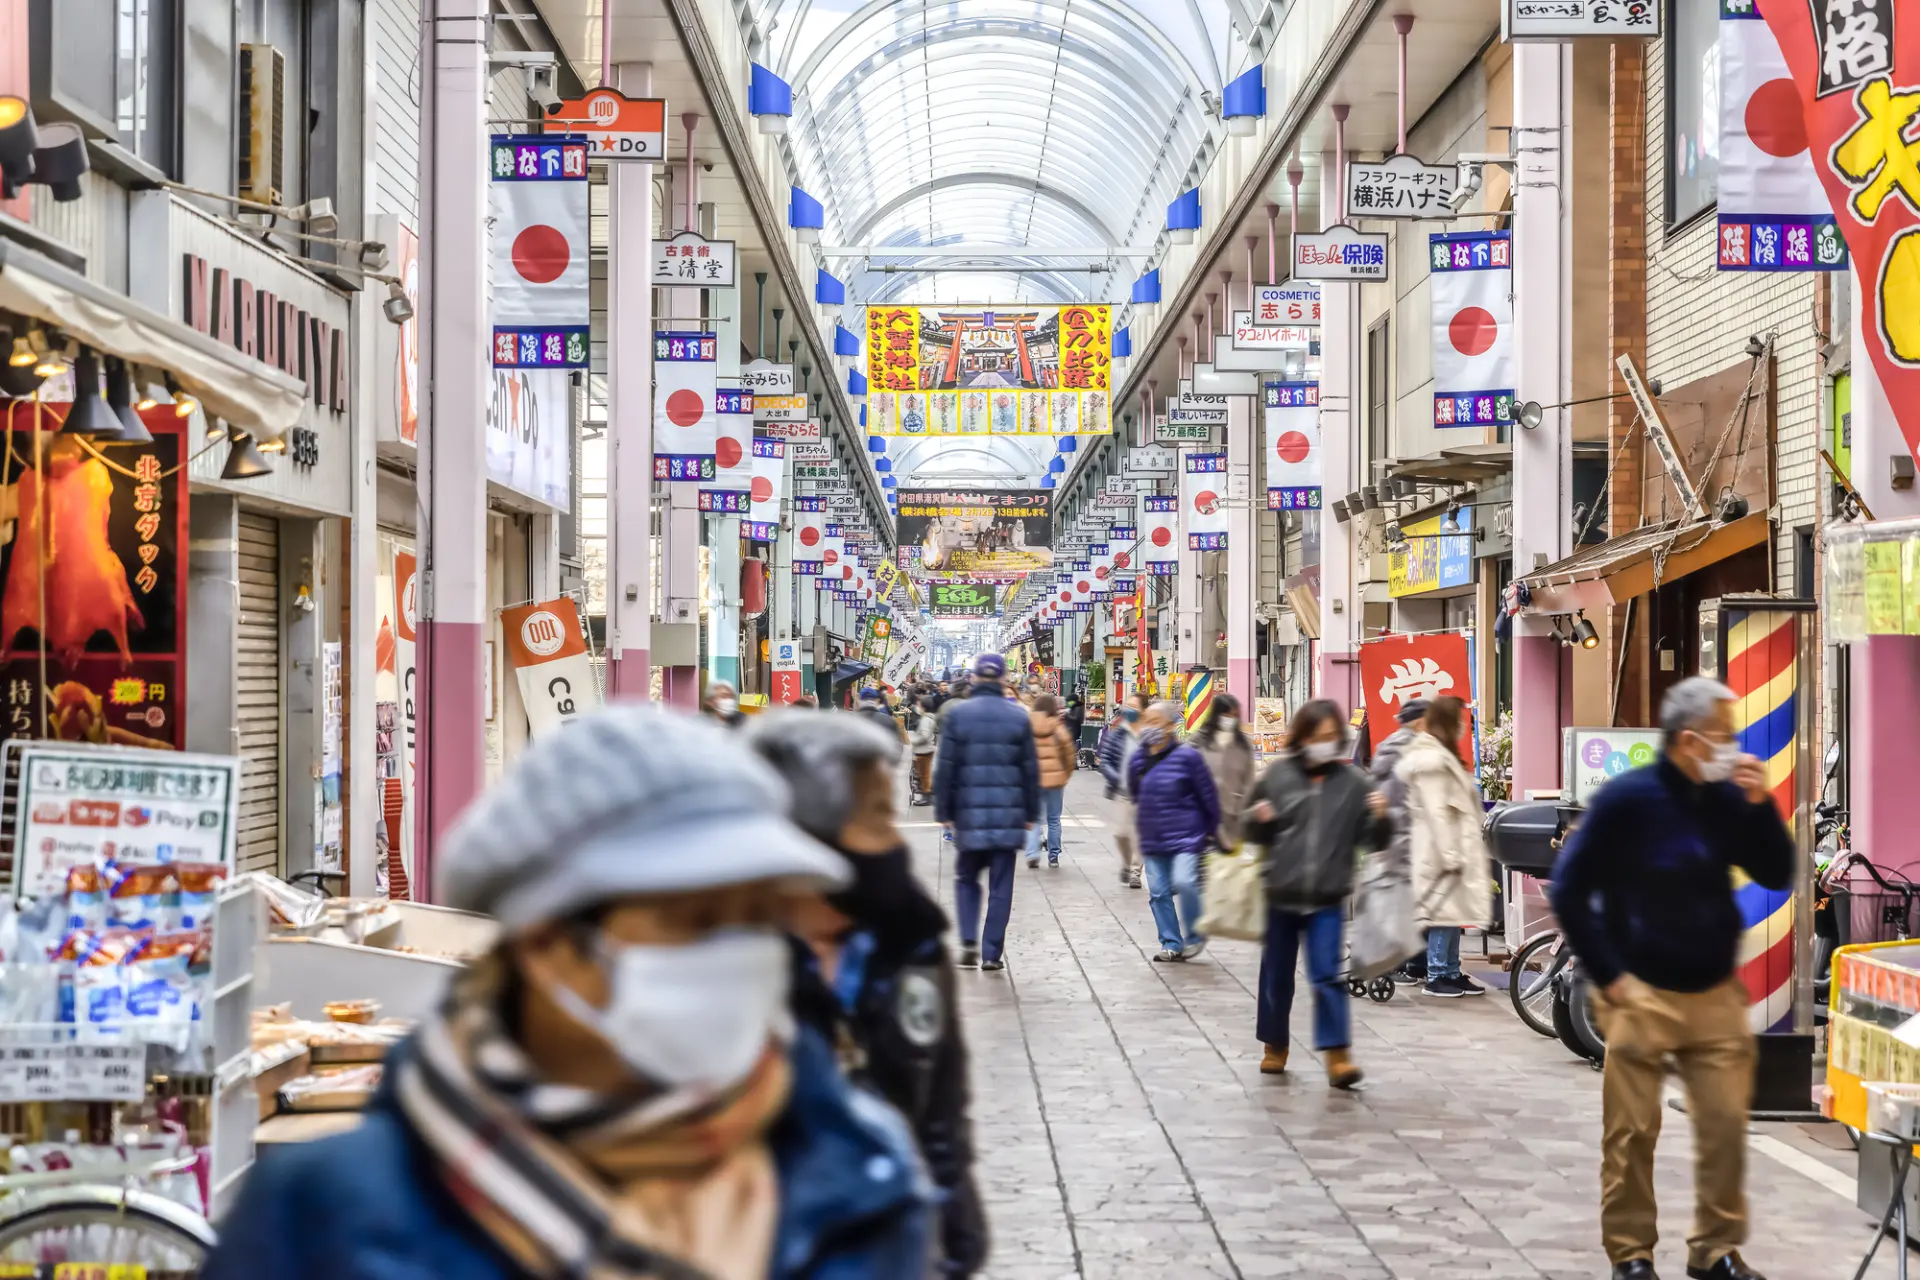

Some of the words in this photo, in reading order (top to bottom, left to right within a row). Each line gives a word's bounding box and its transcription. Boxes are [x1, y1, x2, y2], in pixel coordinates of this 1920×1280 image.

[1824, 0, 1890, 85] 格
[594, 101, 614, 117] 100
[620, 138, 647, 151] Do
[495, 147, 584, 178] 粋な下町
[1358, 171, 1448, 185] フラワーギフト
[1354, 185, 1452, 210] 横浜ハナミ
[665, 245, 710, 257] 古美術
[1433, 241, 1509, 268] 粋な下町
[655, 260, 723, 280] 三清堂
[1350, 266, 1380, 274] 横浜橋店
[183, 253, 345, 413] MARUKIYA
[1236, 328, 1308, 342] タコとハイボール
[740, 373, 791, 386] なみらい
[793, 446, 828, 455] ロちゃん
[134, 454, 162, 594] 北京ダック
